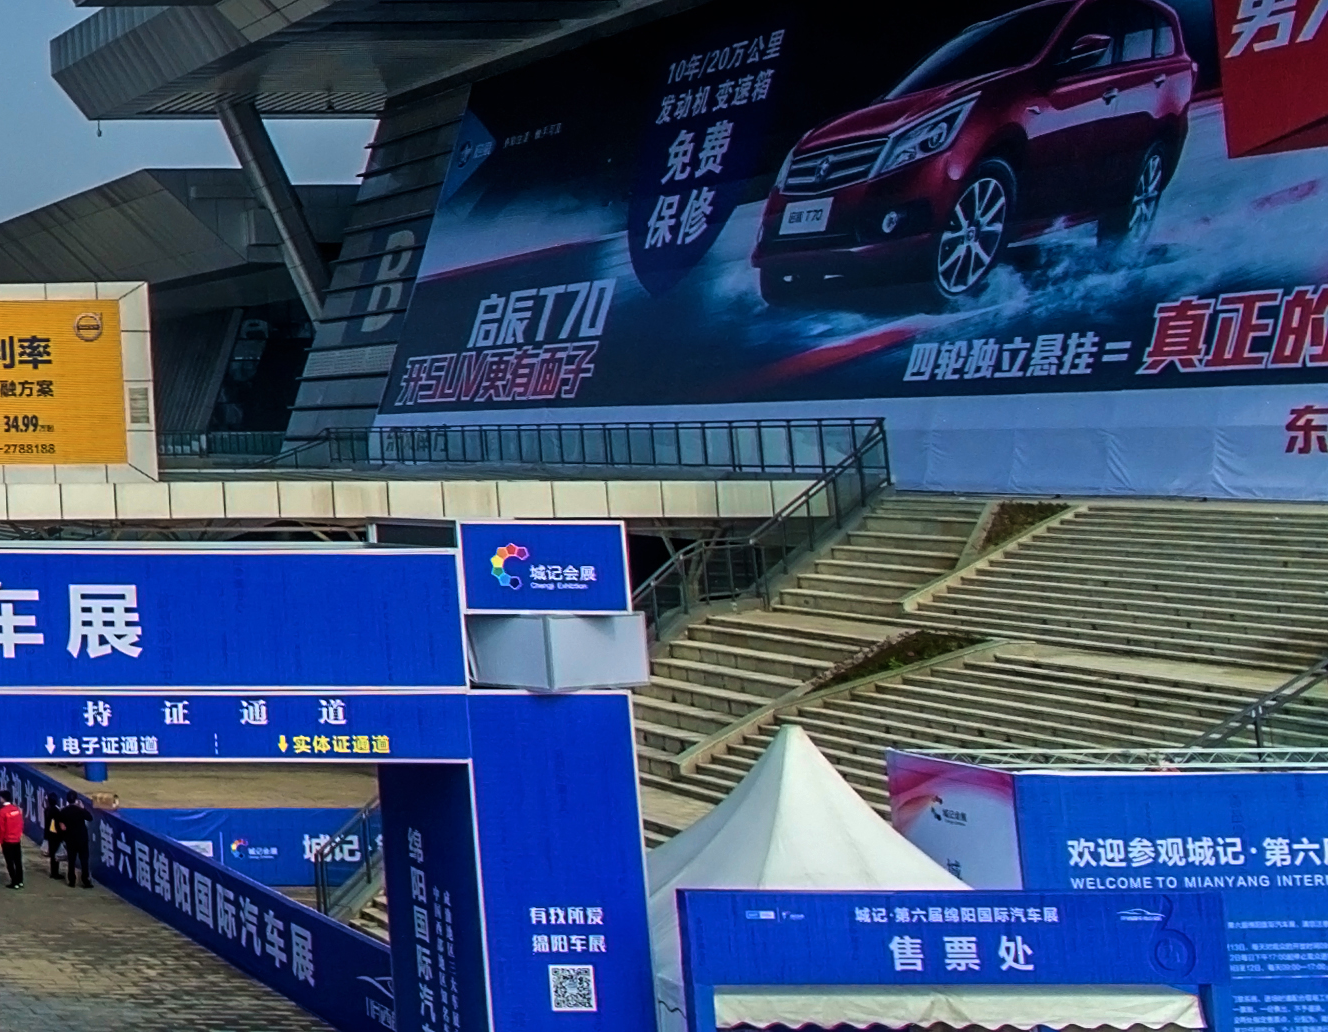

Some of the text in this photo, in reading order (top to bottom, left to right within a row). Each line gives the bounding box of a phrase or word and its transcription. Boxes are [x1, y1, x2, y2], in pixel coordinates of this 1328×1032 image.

[667, 29, 785, 84] 10年/20万公里
[656, 68, 776, 125] 发动机 变速箱
[660, 120, 734, 186] 免费
[644, 186, 716, 250] 保修
[467, 276, 617, 348] 启辰T70
[394, 340, 600, 406] 开SUV更有面子
[530, 565, 596, 580] 城记会展
[83, 700, 347, 726] 持证通道
[61, 736, 158, 755] 电子证通道
[293, 735, 390, 754] 实体证通道
[1067, 836, 1328, 868] 欢迎参观城记·第六
[1071, 874, 1328, 889] WELCOME TO MIANYANG INTER
[529, 907, 604, 925] 有我所爱
[854, 906, 1059, 924] 城记·第六届绵阳国际汽车展
[532, 934, 607, 953] 绵阳车展
[890, 935, 1036, 972] 售票处
